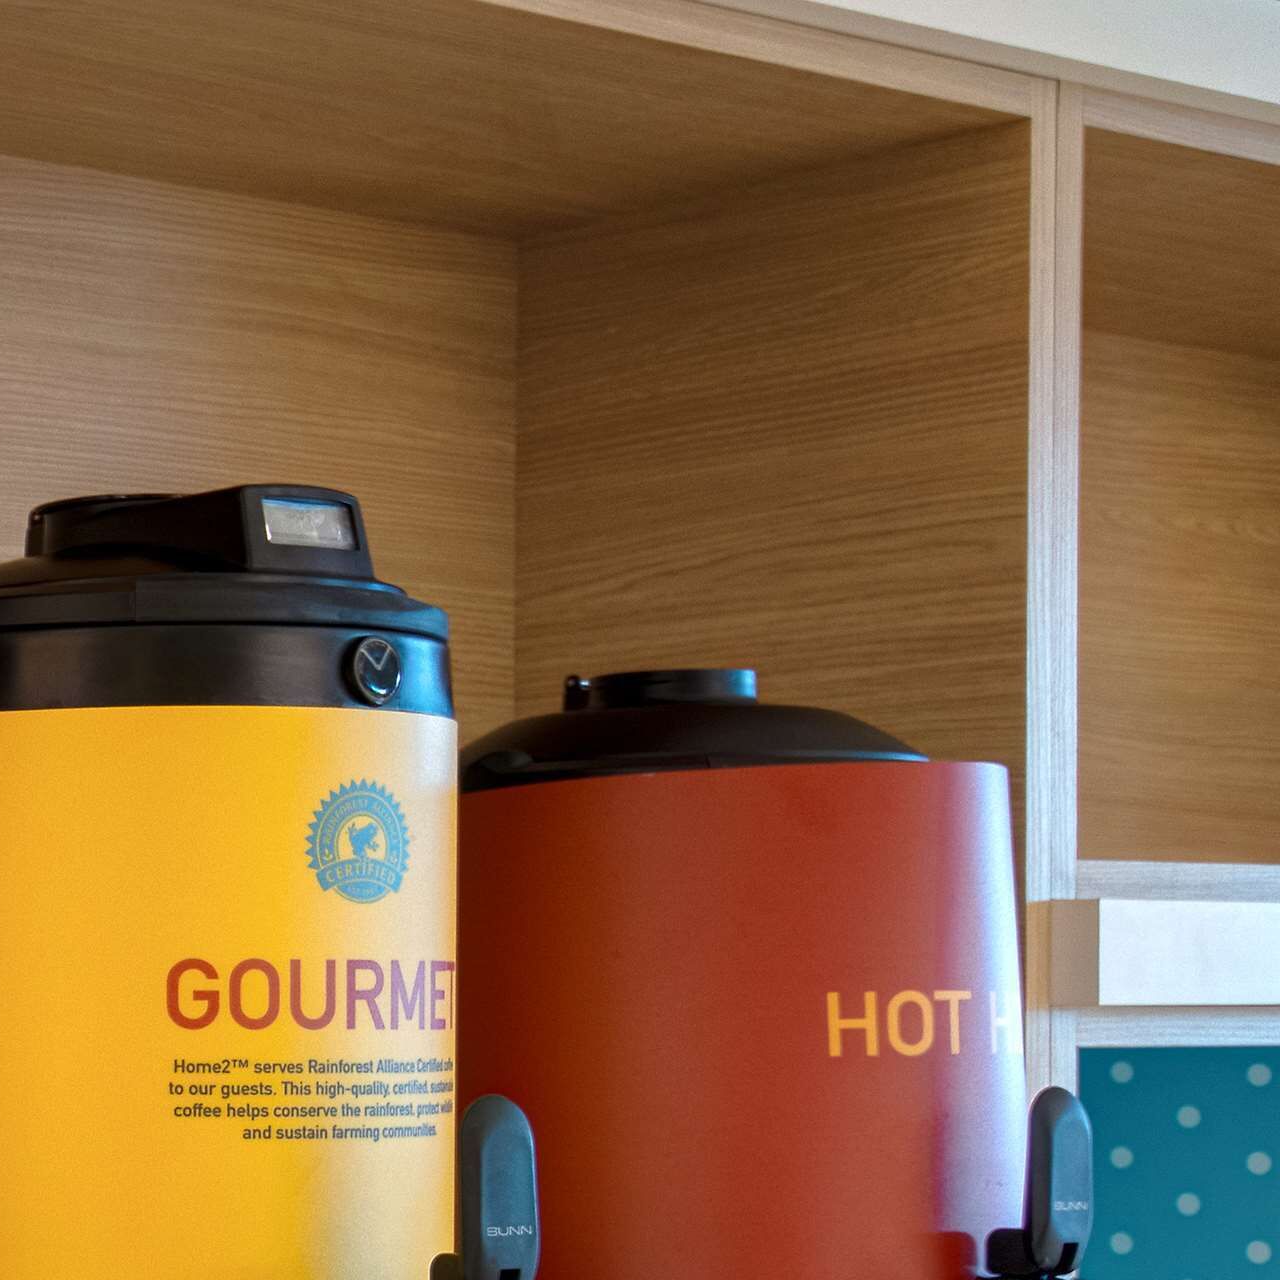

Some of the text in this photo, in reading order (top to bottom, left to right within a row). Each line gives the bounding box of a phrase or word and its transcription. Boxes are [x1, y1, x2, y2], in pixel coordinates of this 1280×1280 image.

[827, 989, 972, 1057] HOT
[254, 1062, 304, 1074] serves
[308, 1059, 373, 1074] Rainforest
[376, 1059, 417, 1073] Alliance
[169, 1082, 184, 1095] to
[189, 1084, 216, 1096] our
[221, 1082, 277, 1099] guests.
[281, 1081, 312, 1095] This
[174, 1103, 222, 1118] coffee
[226, 1104, 269, 1120] helps
[273, 1105, 337, 1118] conserve
[341, 1103, 362, 1117] the
[243, 1125, 272, 1140] and
[276, 1125, 328, 1140] sustain
[332, 1125, 380, 1142] farming
[486, 1225, 533, 1237] BUNN
